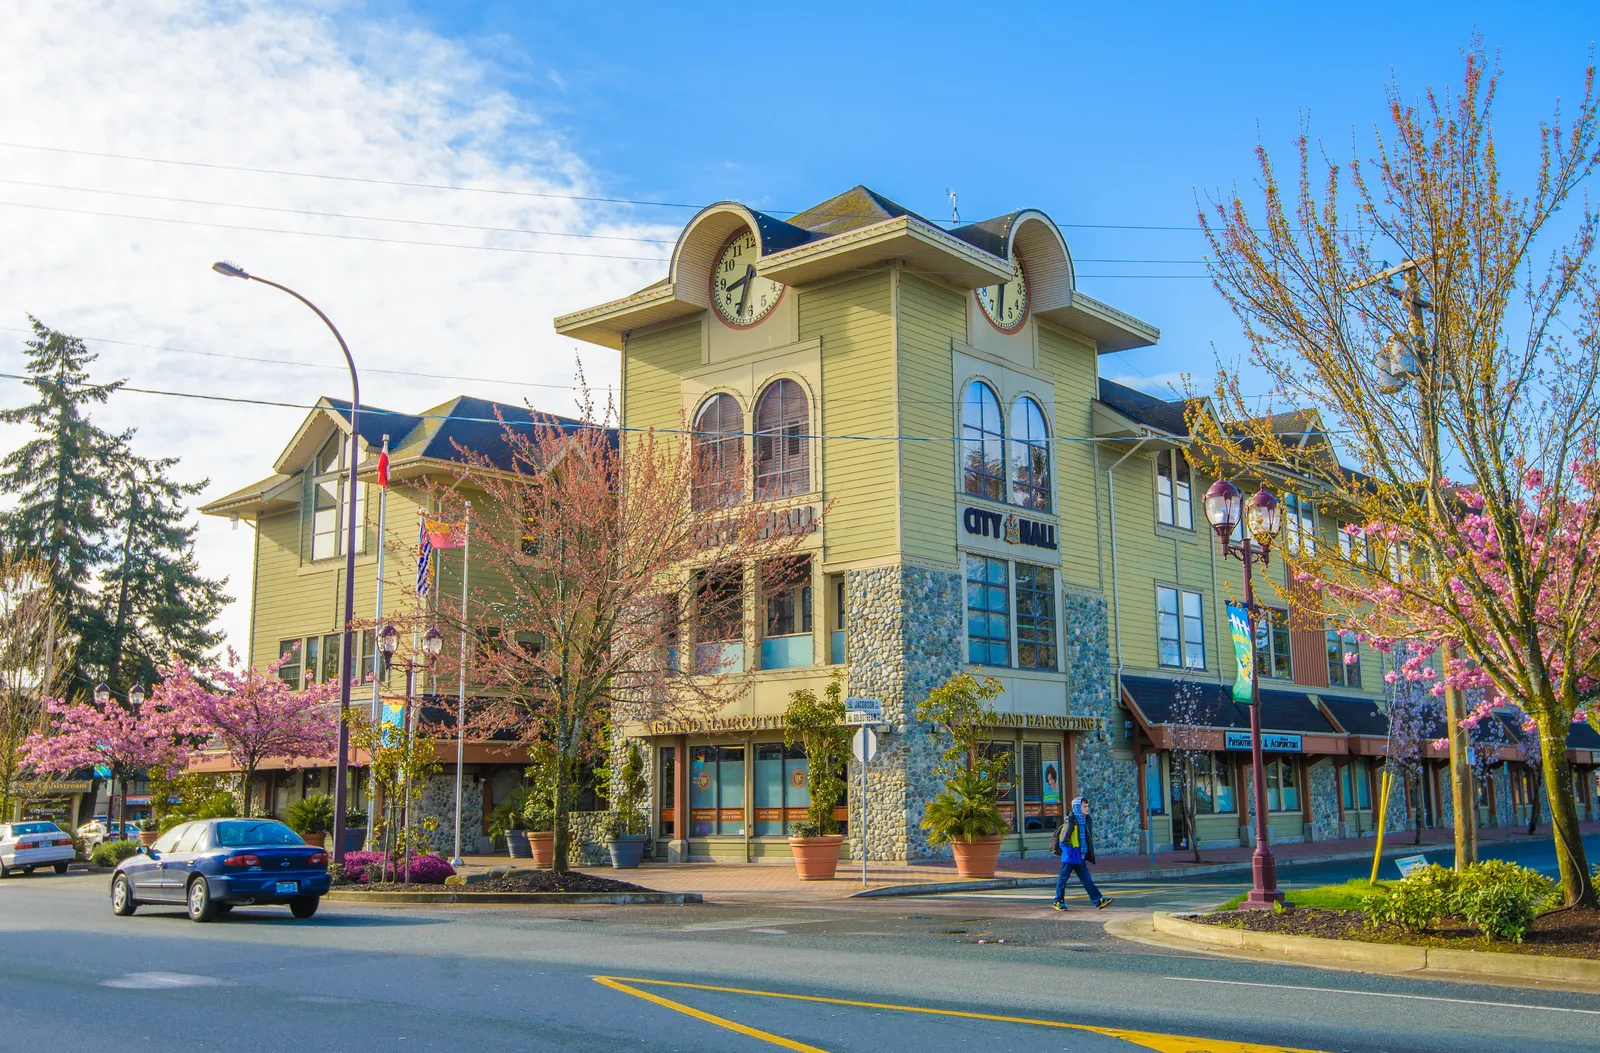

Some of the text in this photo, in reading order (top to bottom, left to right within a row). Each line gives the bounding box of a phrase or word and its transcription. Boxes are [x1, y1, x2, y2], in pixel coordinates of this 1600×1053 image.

[733, 245, 742, 258] 11
[724, 259, 735, 272] 10
[720, 278, 726, 290] 9
[770, 281, 776, 292] 4
[1017, 283, 1022, 295] 3
[726, 293, 732, 306] 8
[761, 295, 767, 307] 5
[990, 299, 994, 311] 7
[1014, 299, 1019, 310] 4
[748, 304, 754, 317] 6
[1008, 307, 1013, 320] 5
[964, 507, 1057, 550] CITY HALL
[652, 714, 788, 734] ISLAND HAIRCUTTI
[1026, 714, 1094, 730] HAIRCUTTING
